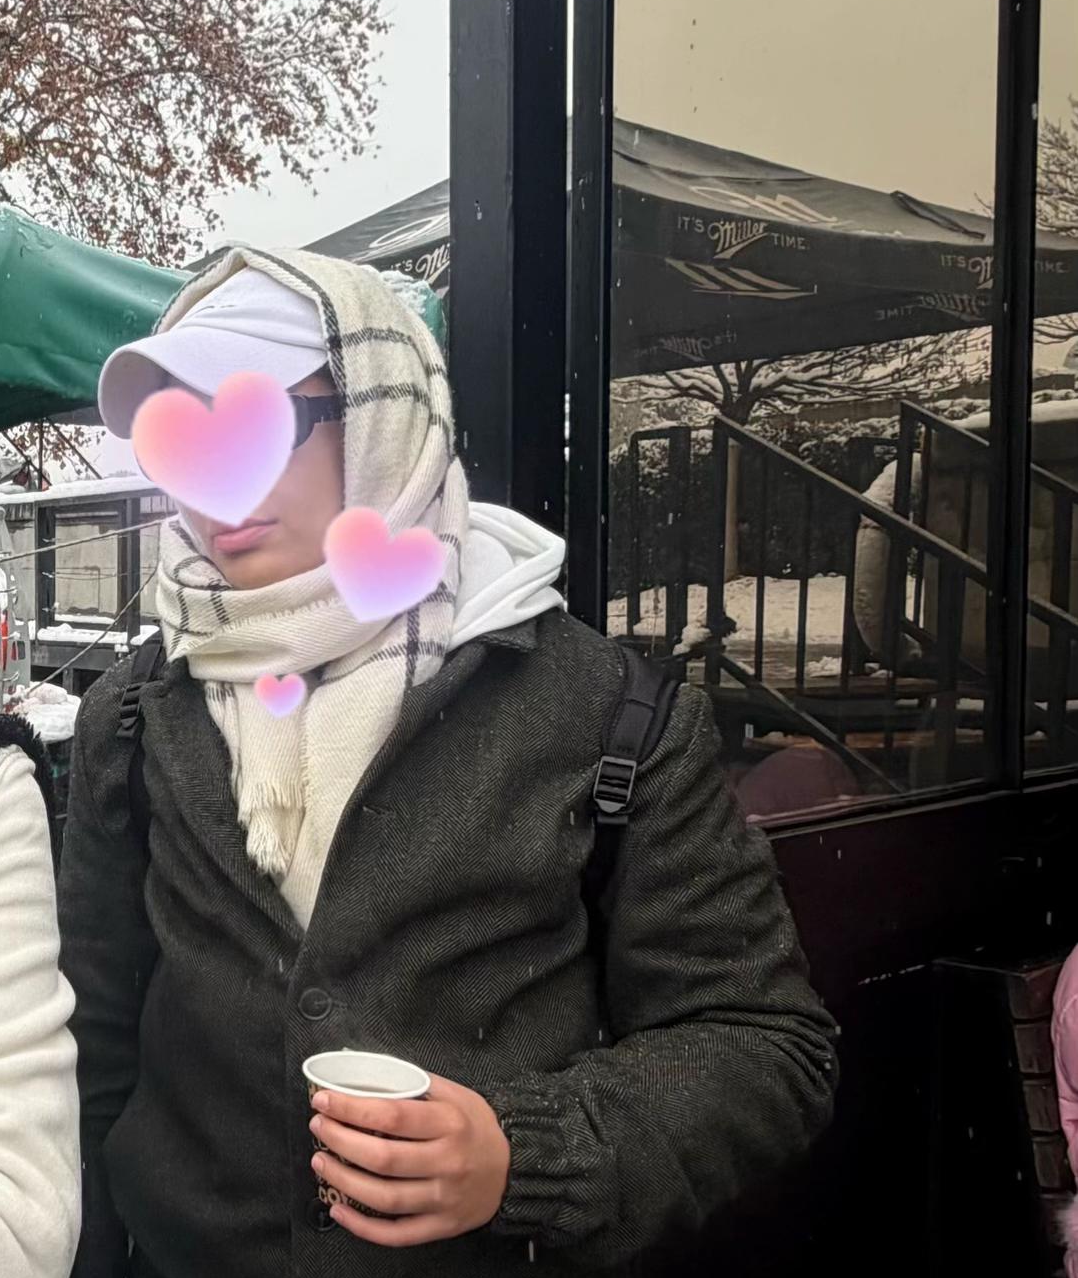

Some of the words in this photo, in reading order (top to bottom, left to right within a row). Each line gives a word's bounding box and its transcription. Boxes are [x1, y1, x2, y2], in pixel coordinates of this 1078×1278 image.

[678, 216, 705, 233] IT'S
[707, 220, 768, 259] Miller
[940, 254, 965, 267] IT'S
